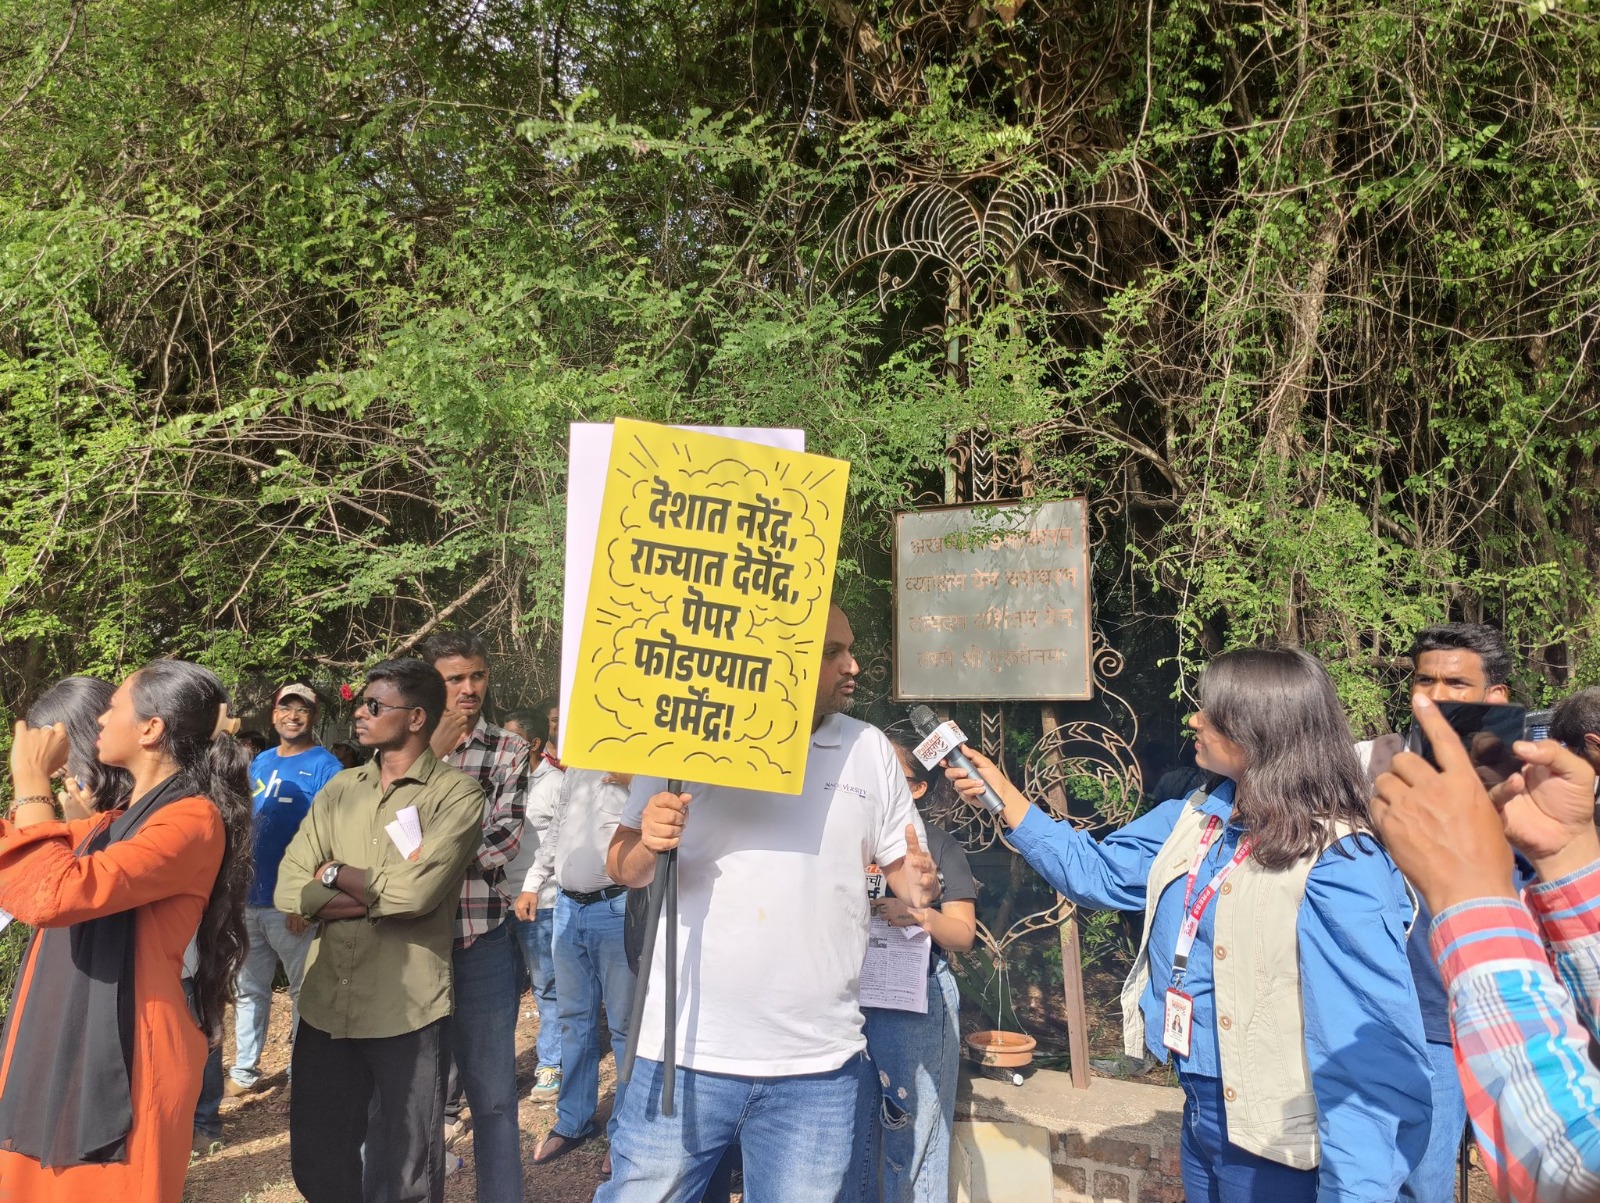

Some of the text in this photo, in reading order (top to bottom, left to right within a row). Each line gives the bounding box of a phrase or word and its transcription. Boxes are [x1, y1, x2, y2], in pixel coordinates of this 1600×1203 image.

[649, 476, 797, 552] देशात नरेंद्र,
[630, 537, 800, 605] राज्यात देवेंद्र,
[682, 585, 741, 641] पेपर
[634, 628, 772, 694] फोडण्यात
[653, 685, 735, 742] धर्मेंद्र!
[916, 731, 940, 755] Political
[1193, 889, 1211, 916] PRESS
